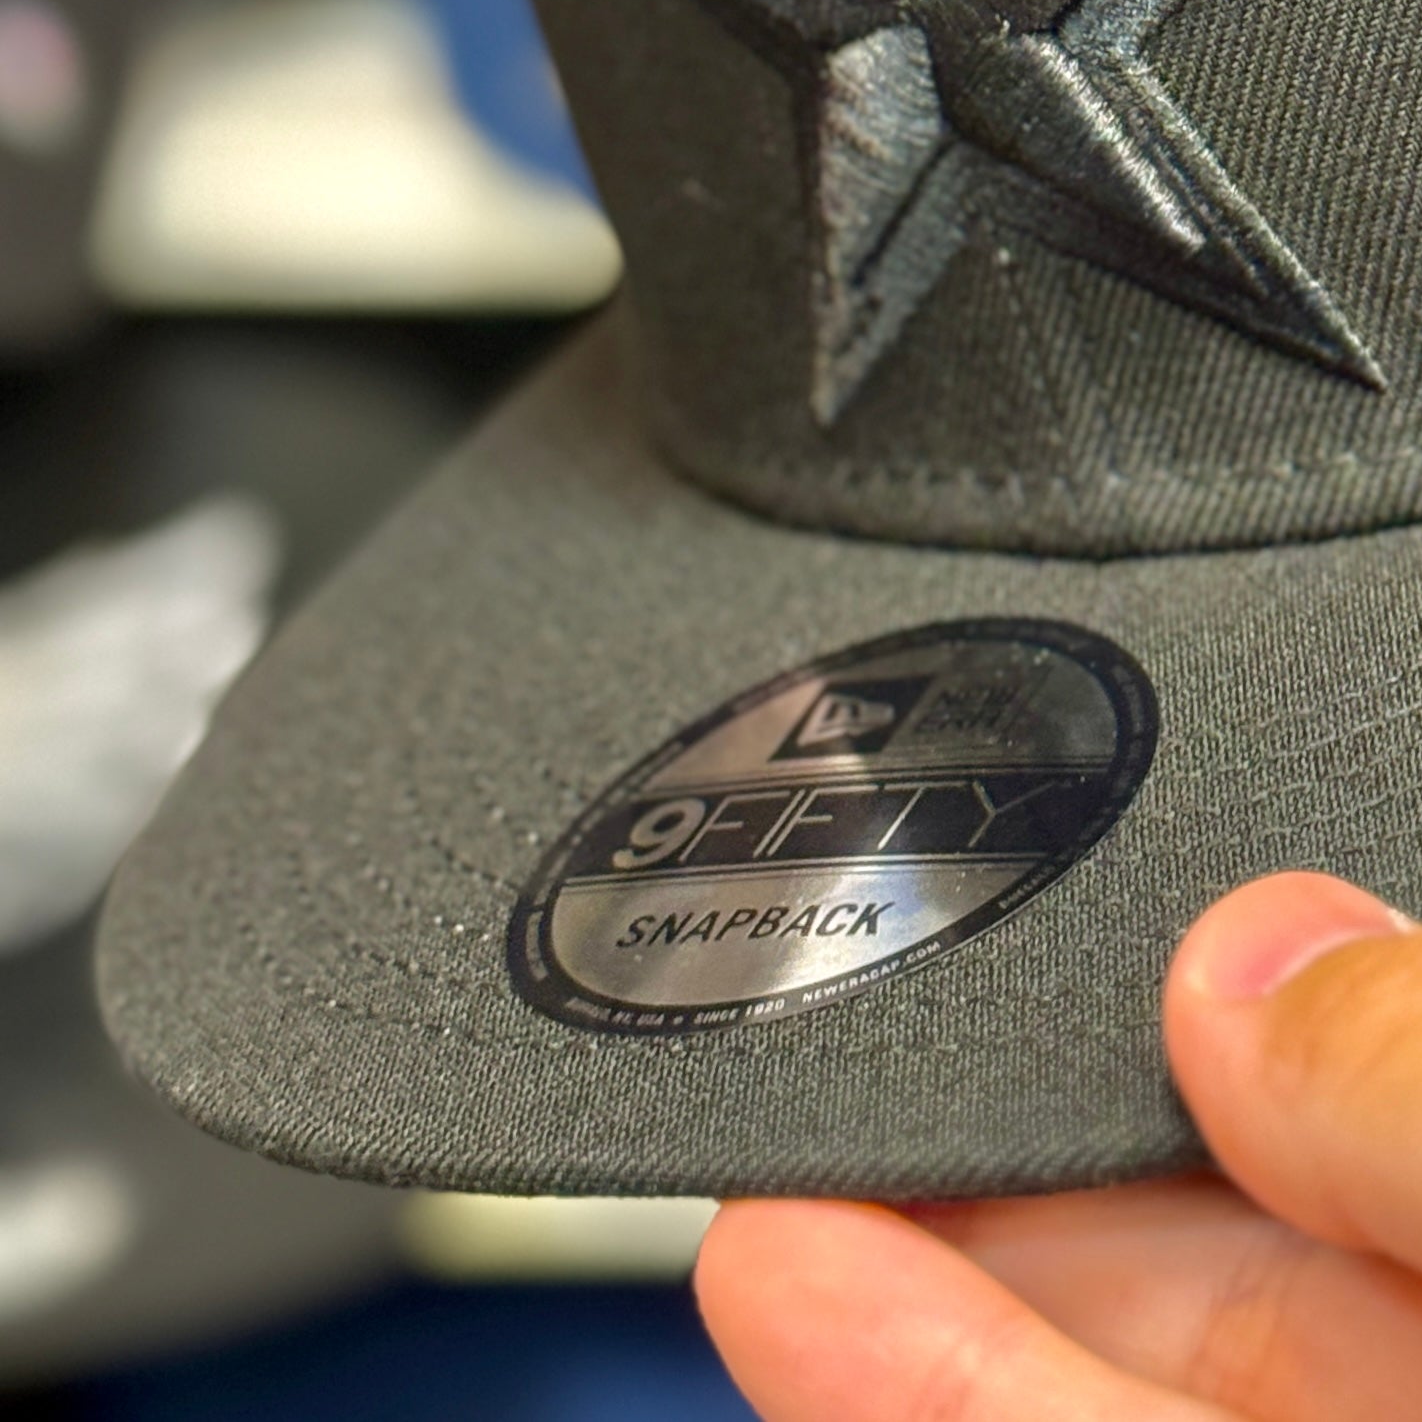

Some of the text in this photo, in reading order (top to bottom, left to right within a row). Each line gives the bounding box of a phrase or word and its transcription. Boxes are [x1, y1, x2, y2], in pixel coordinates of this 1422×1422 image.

[612, 779, 1056, 870] 9FIFTY
[616, 901, 896, 948] SNAPBACK
[693, 1006, 740, 1024] SINCE
[744, 997, 786, 1018] 1920
[802, 940, 942, 1004] NEWERACAP.COM
